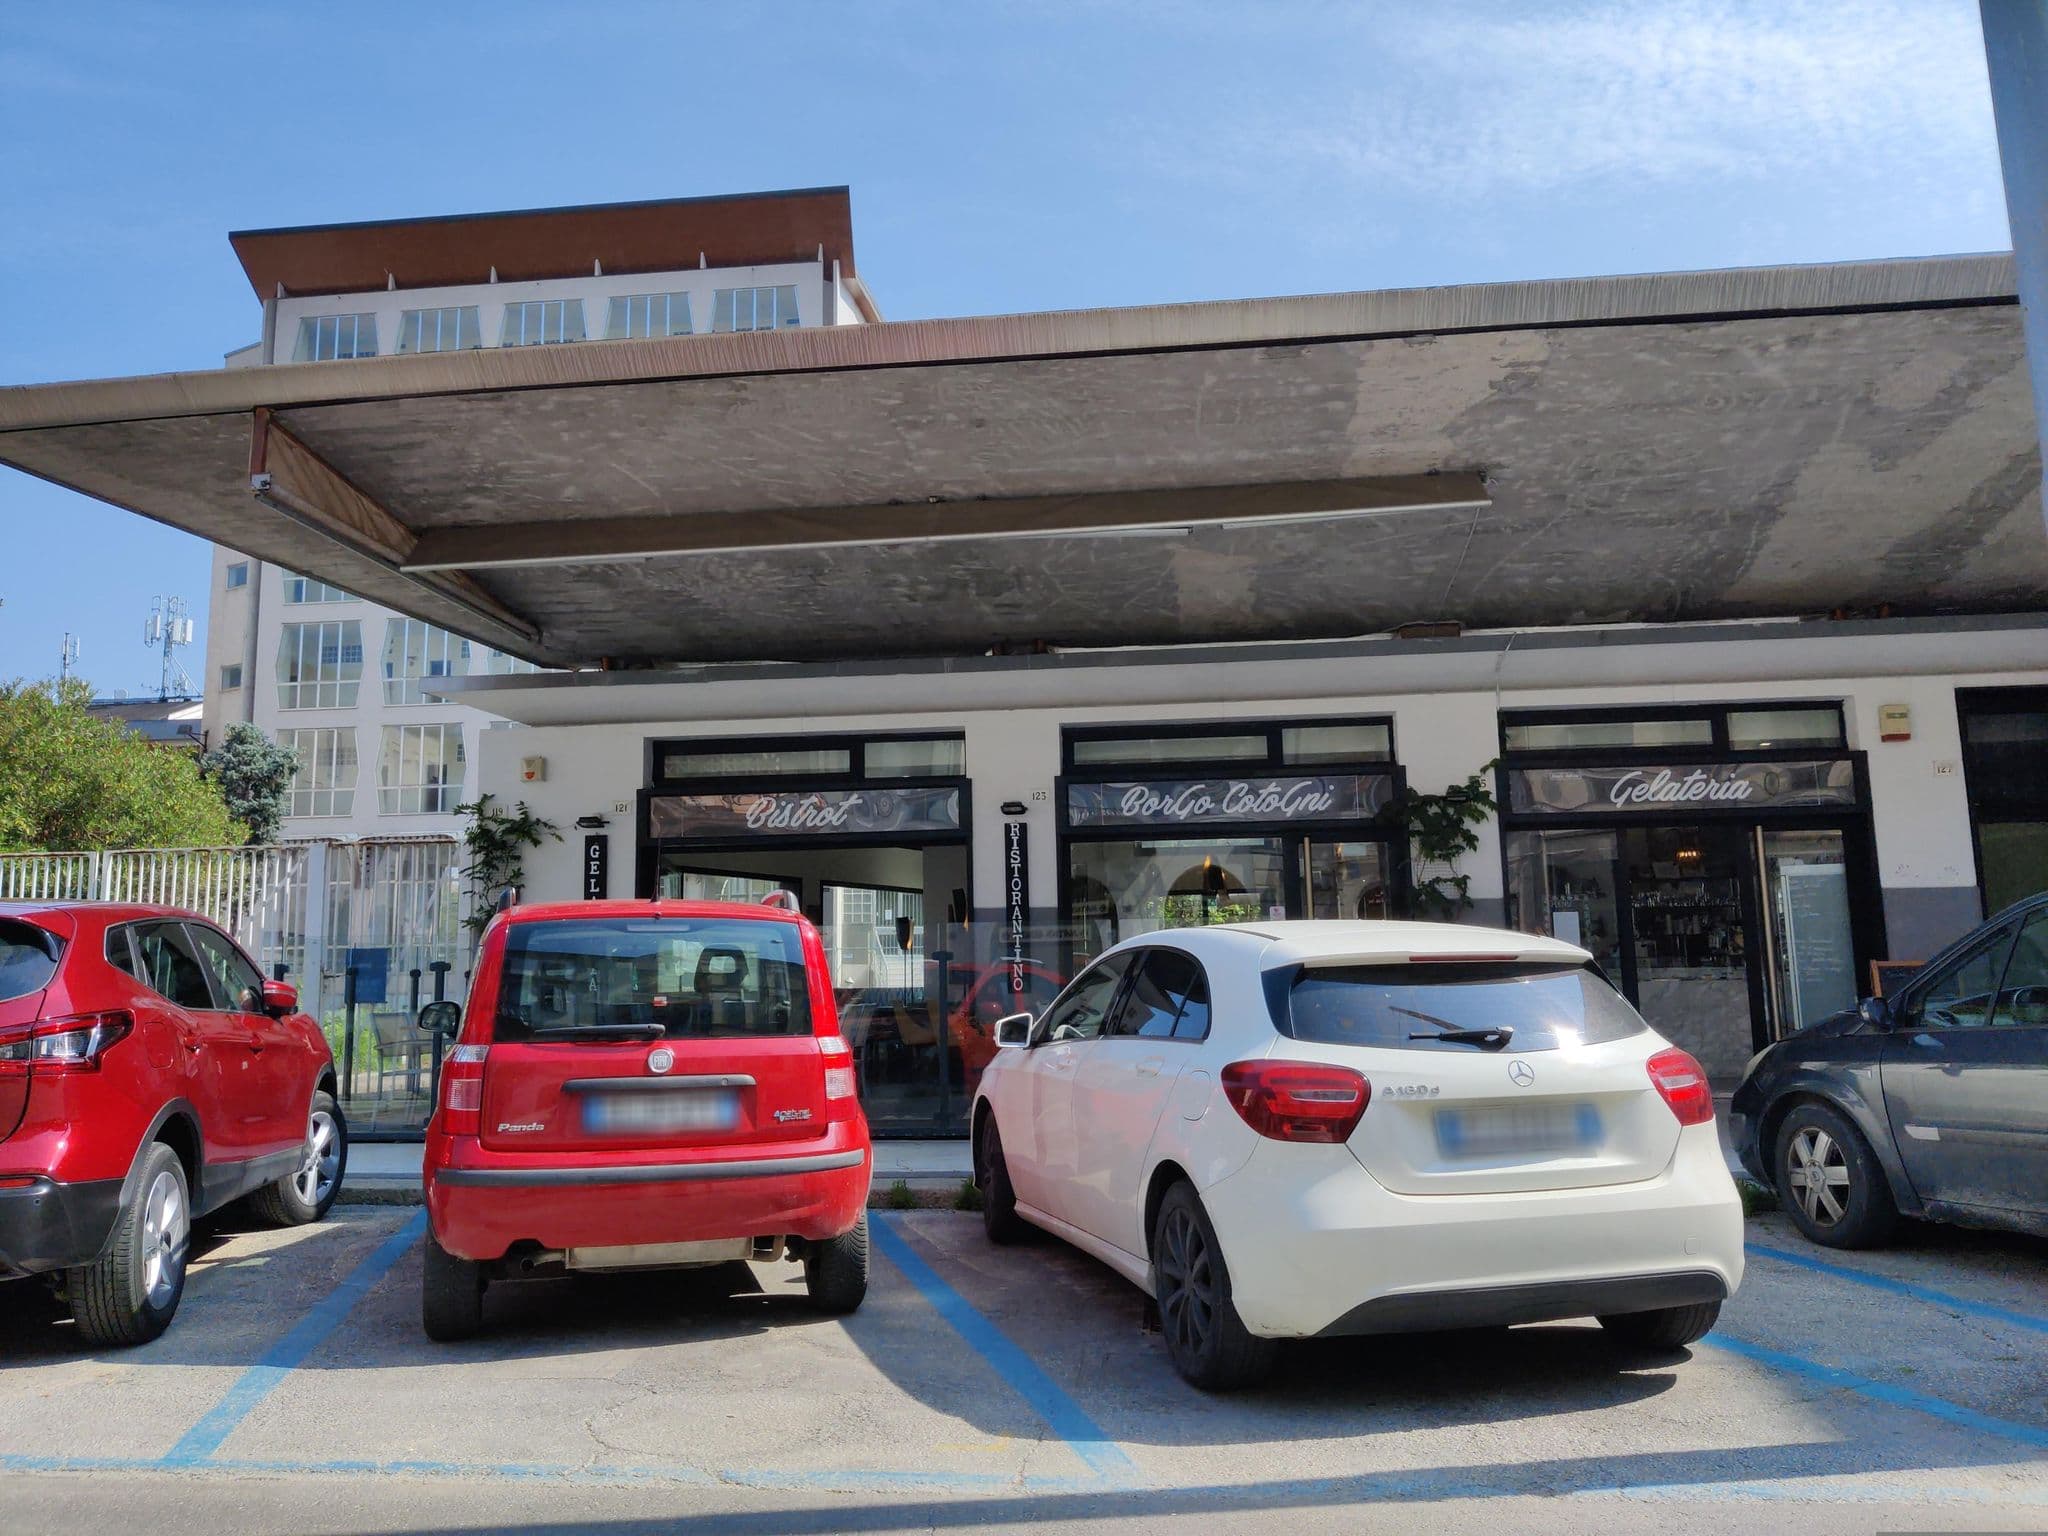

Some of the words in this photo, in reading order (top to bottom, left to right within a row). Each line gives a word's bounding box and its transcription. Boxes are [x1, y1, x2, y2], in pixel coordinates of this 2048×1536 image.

[1032, 791, 1047, 801] 123
[1610, 768, 1752, 808] Gelateria
[615, 804, 627, 813] 121
[746, 793, 864, 829] Bistrot
[1009, 823, 1024, 991] RISTORANTINO
[497, 1121, 545, 1132] Panda
